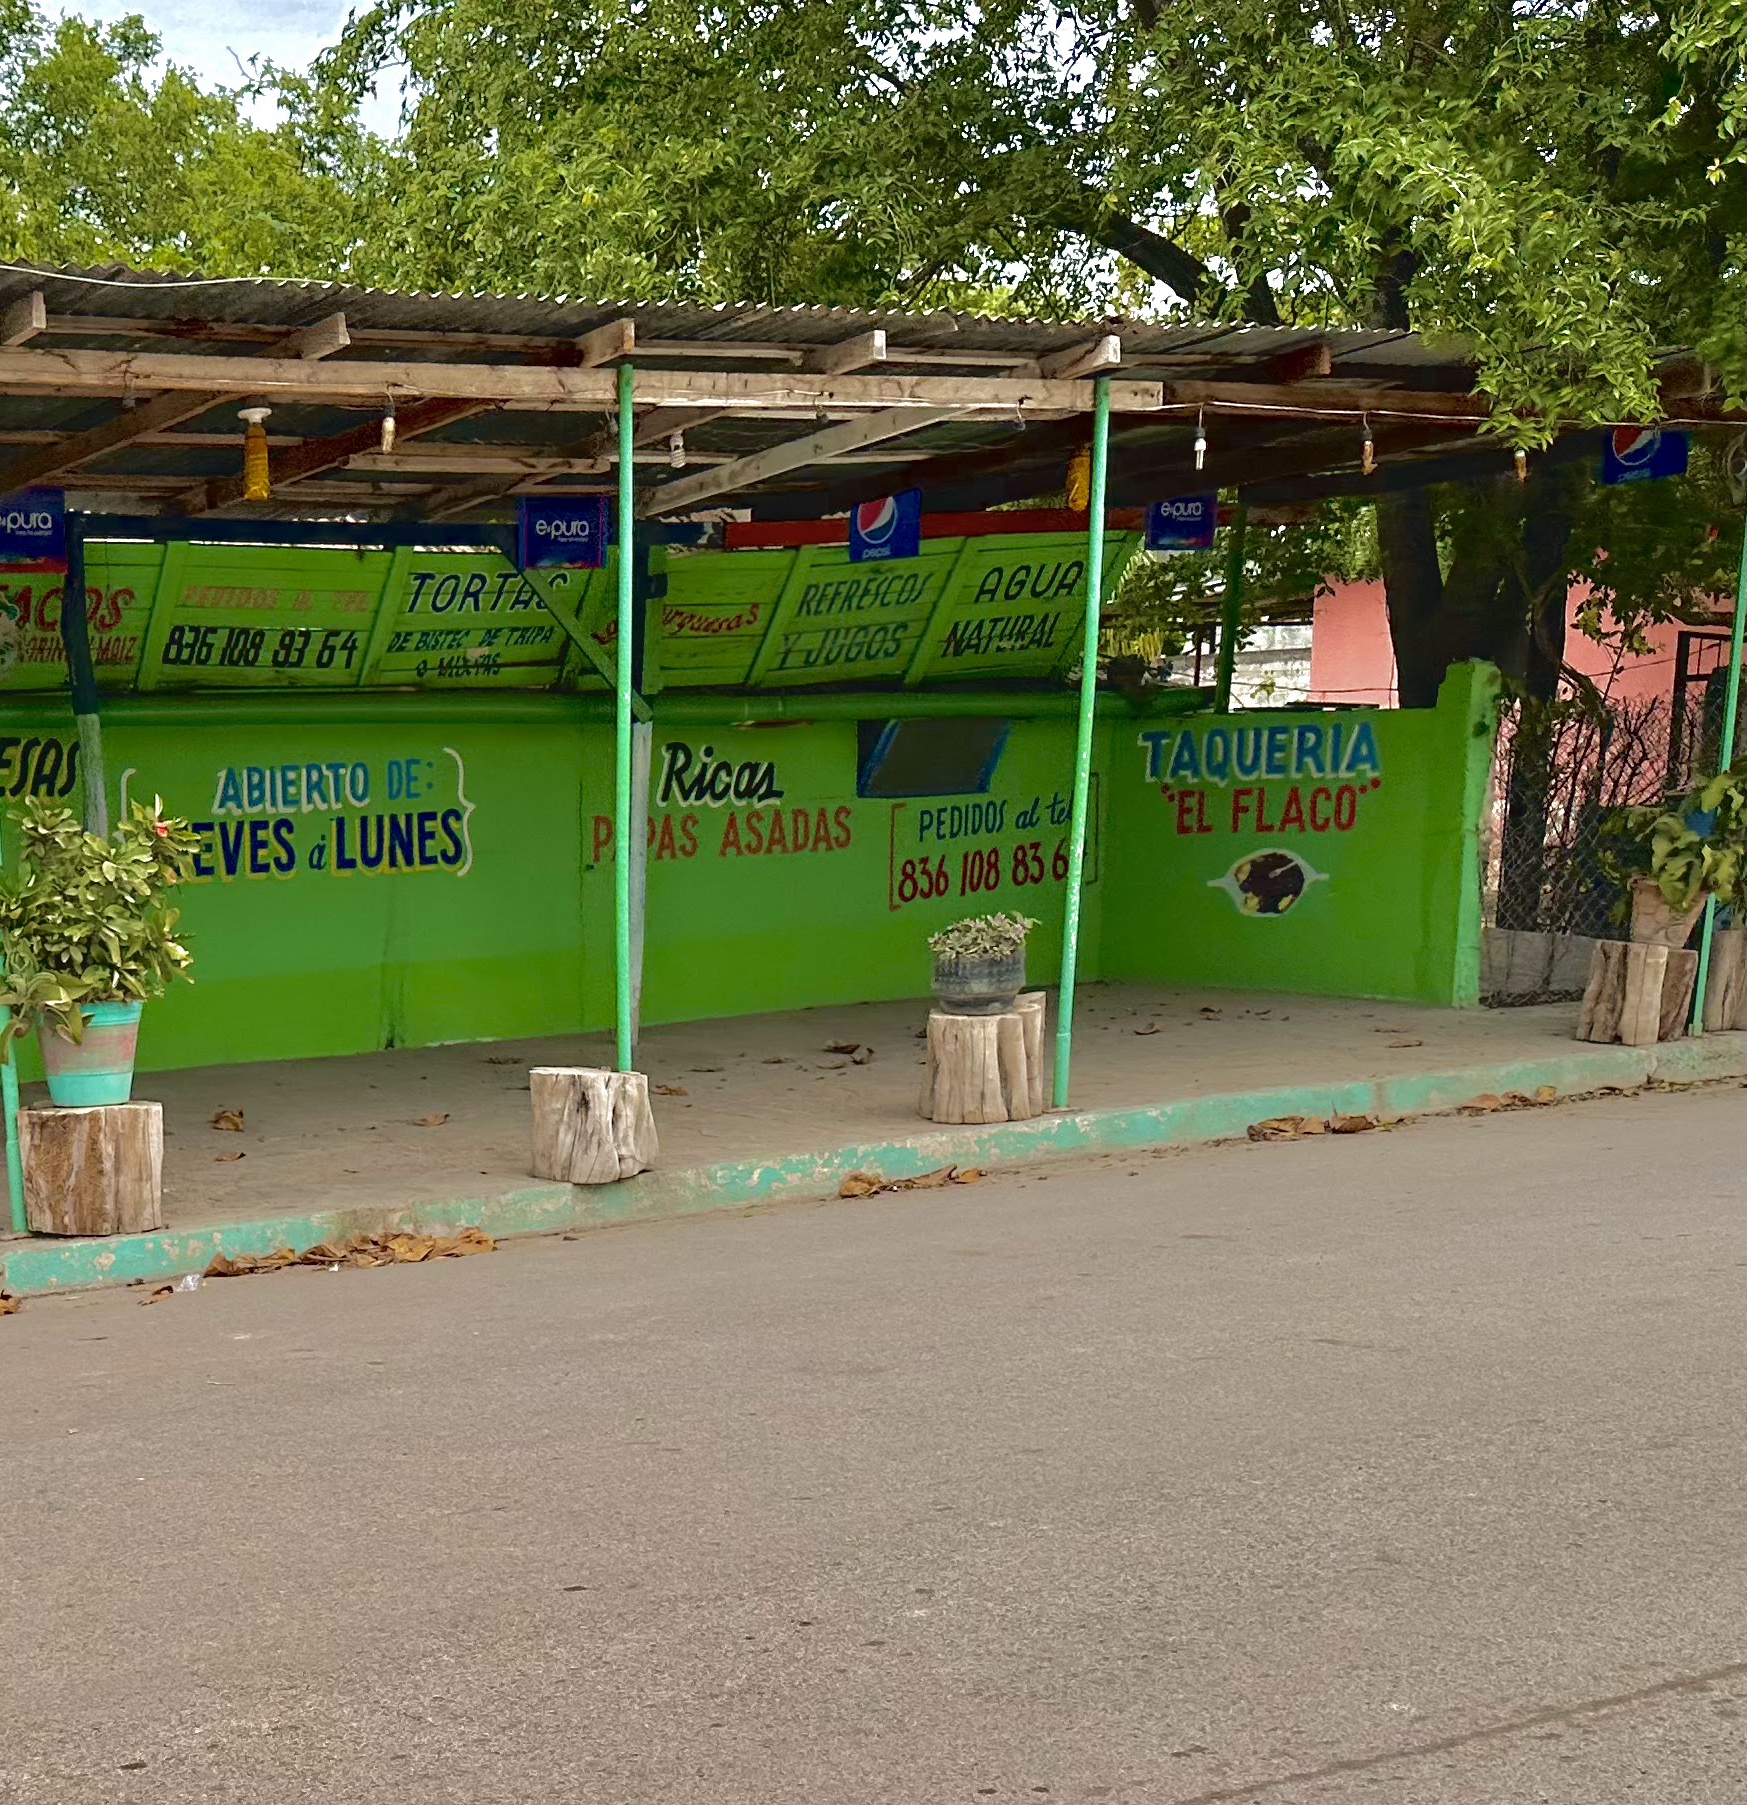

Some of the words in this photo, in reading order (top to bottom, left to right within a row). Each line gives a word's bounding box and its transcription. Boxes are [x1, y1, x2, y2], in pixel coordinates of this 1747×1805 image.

[796, 572, 934, 618] REFRESCOS
[973, 560, 1085, 603] AGUA
[162, 625, 218, 666] 836
[219, 628, 266, 667] 108
[316, 630, 358, 669] 64
[387, 632, 413, 652] DE
[778, 634, 800, 670] Y
[805, 623, 909, 667] JUGOS
[940, 611, 1062, 658] NATURAL
[656, 741, 785, 808] Ricas
[1137, 721, 1380, 787] TAQUERIA
[210, 761, 370, 816] ABIERTO
[332, 809, 465, 877] LUNES
[718, 805, 852, 858] ASADAS
[918, 799, 1007, 842] PEDIDOS
[1015, 797, 1041, 829] al
[898, 854, 949, 902] 836
[959, 847, 1000, 896] 108
[1012, 841, 1045, 886] 83
